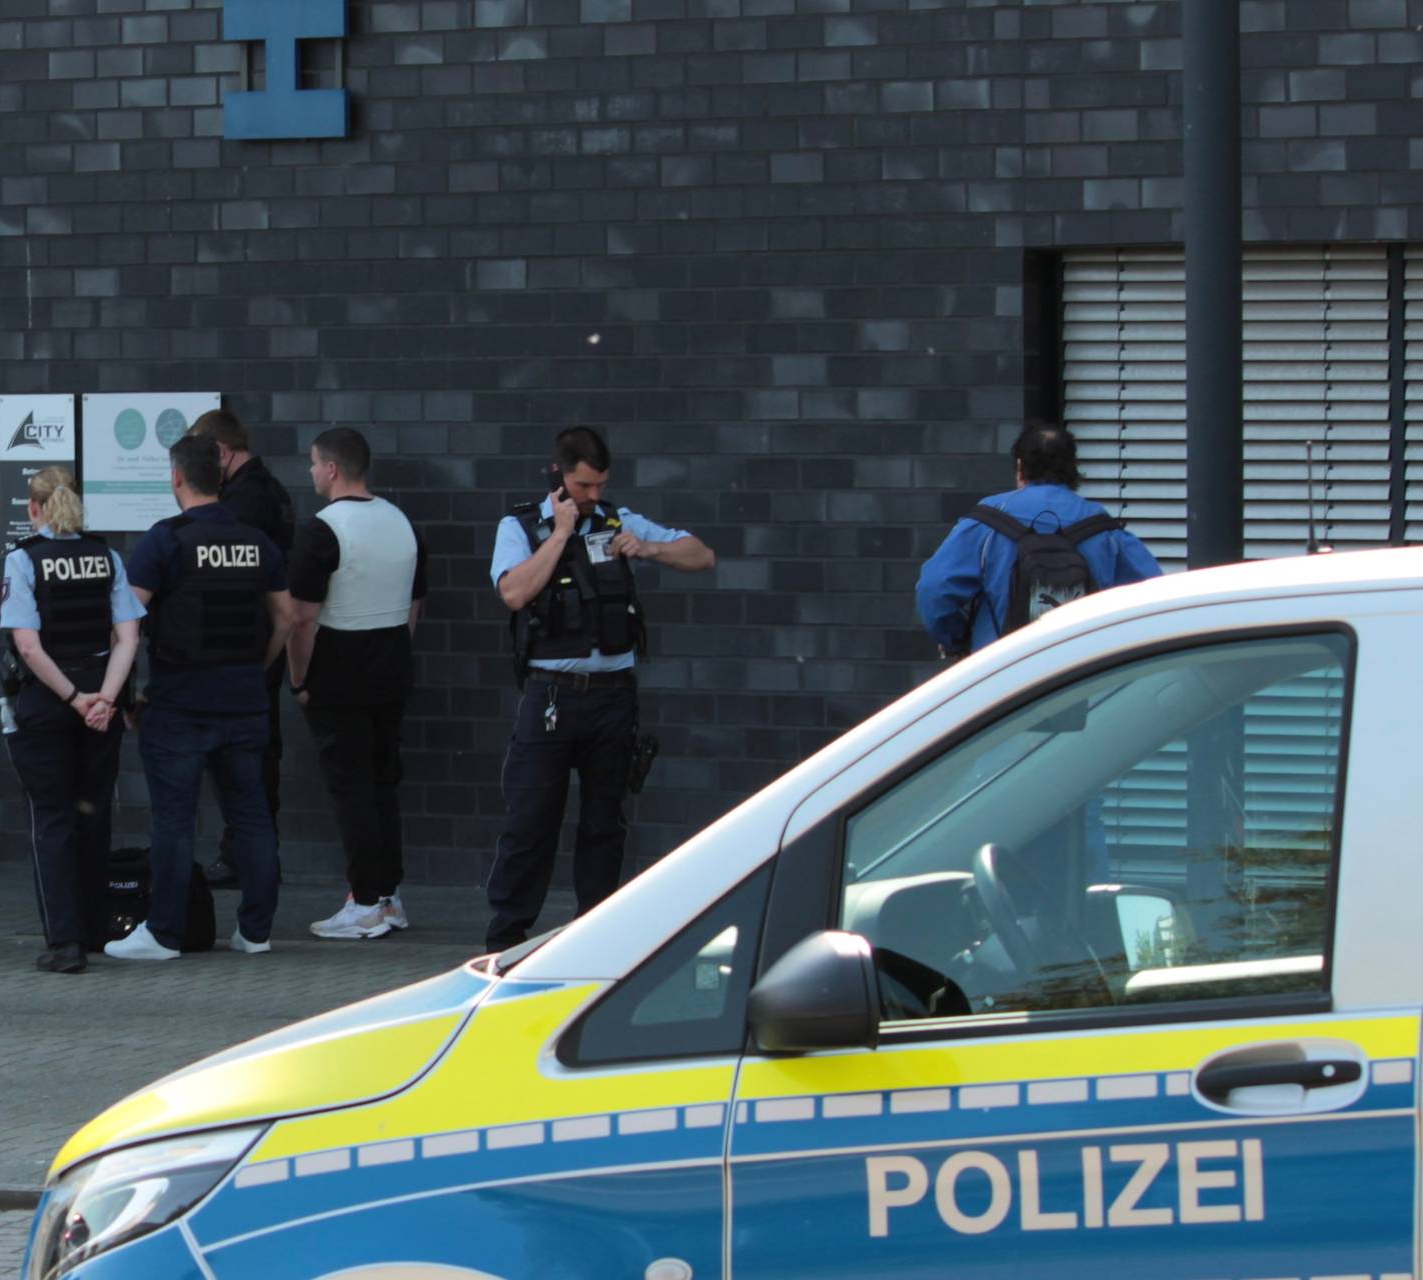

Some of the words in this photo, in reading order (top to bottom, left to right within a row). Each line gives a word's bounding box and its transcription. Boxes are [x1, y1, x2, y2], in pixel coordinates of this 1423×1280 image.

[26, 425, 65, 437] CITY
[41, 556, 111, 581] POLIZEI
[197, 545, 260, 568] POLIZEI
[866, 1139, 1264, 1237] POLIZEI
